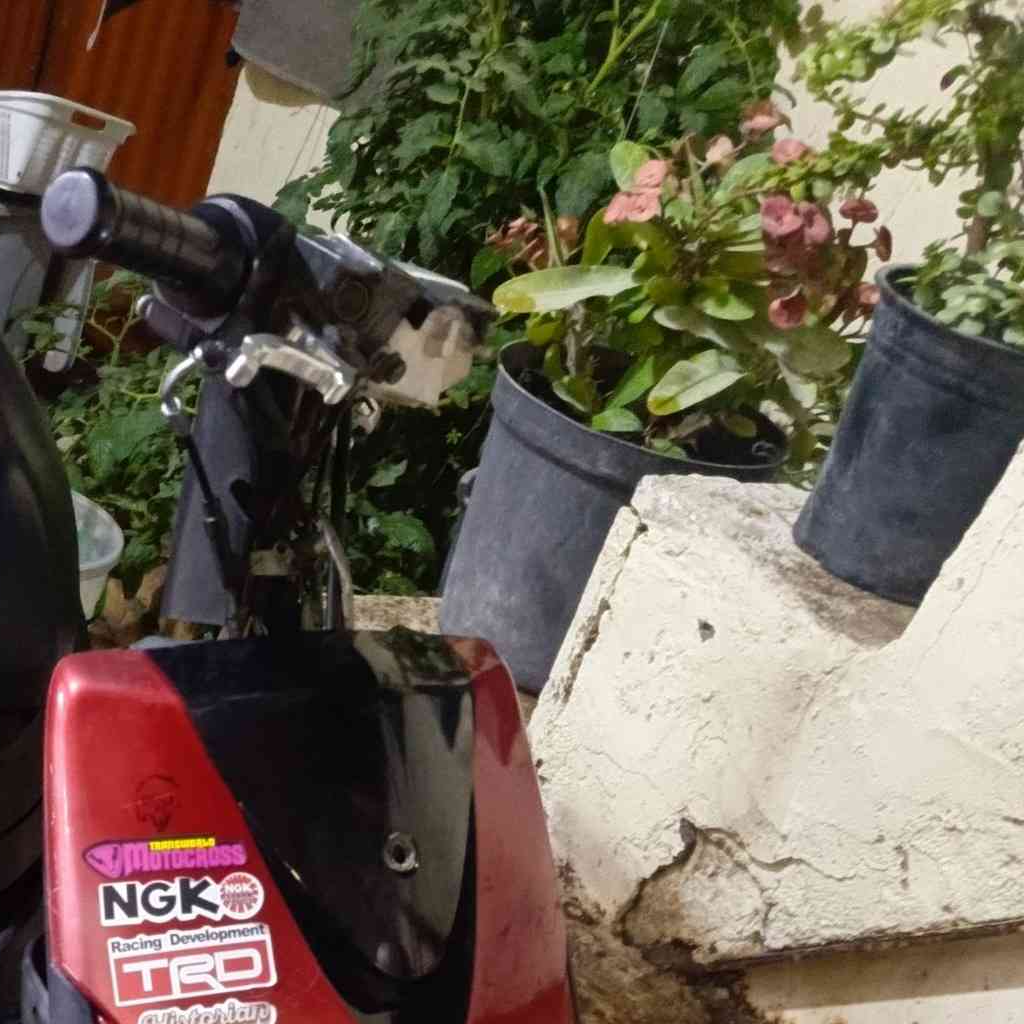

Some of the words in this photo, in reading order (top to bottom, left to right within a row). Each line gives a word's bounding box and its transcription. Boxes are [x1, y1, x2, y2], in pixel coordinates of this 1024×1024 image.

[103, 878, 219, 920] NGK
[111, 938, 162, 954] Racing
[169, 924, 265, 947] Development
[122, 948, 263, 994] TRD
